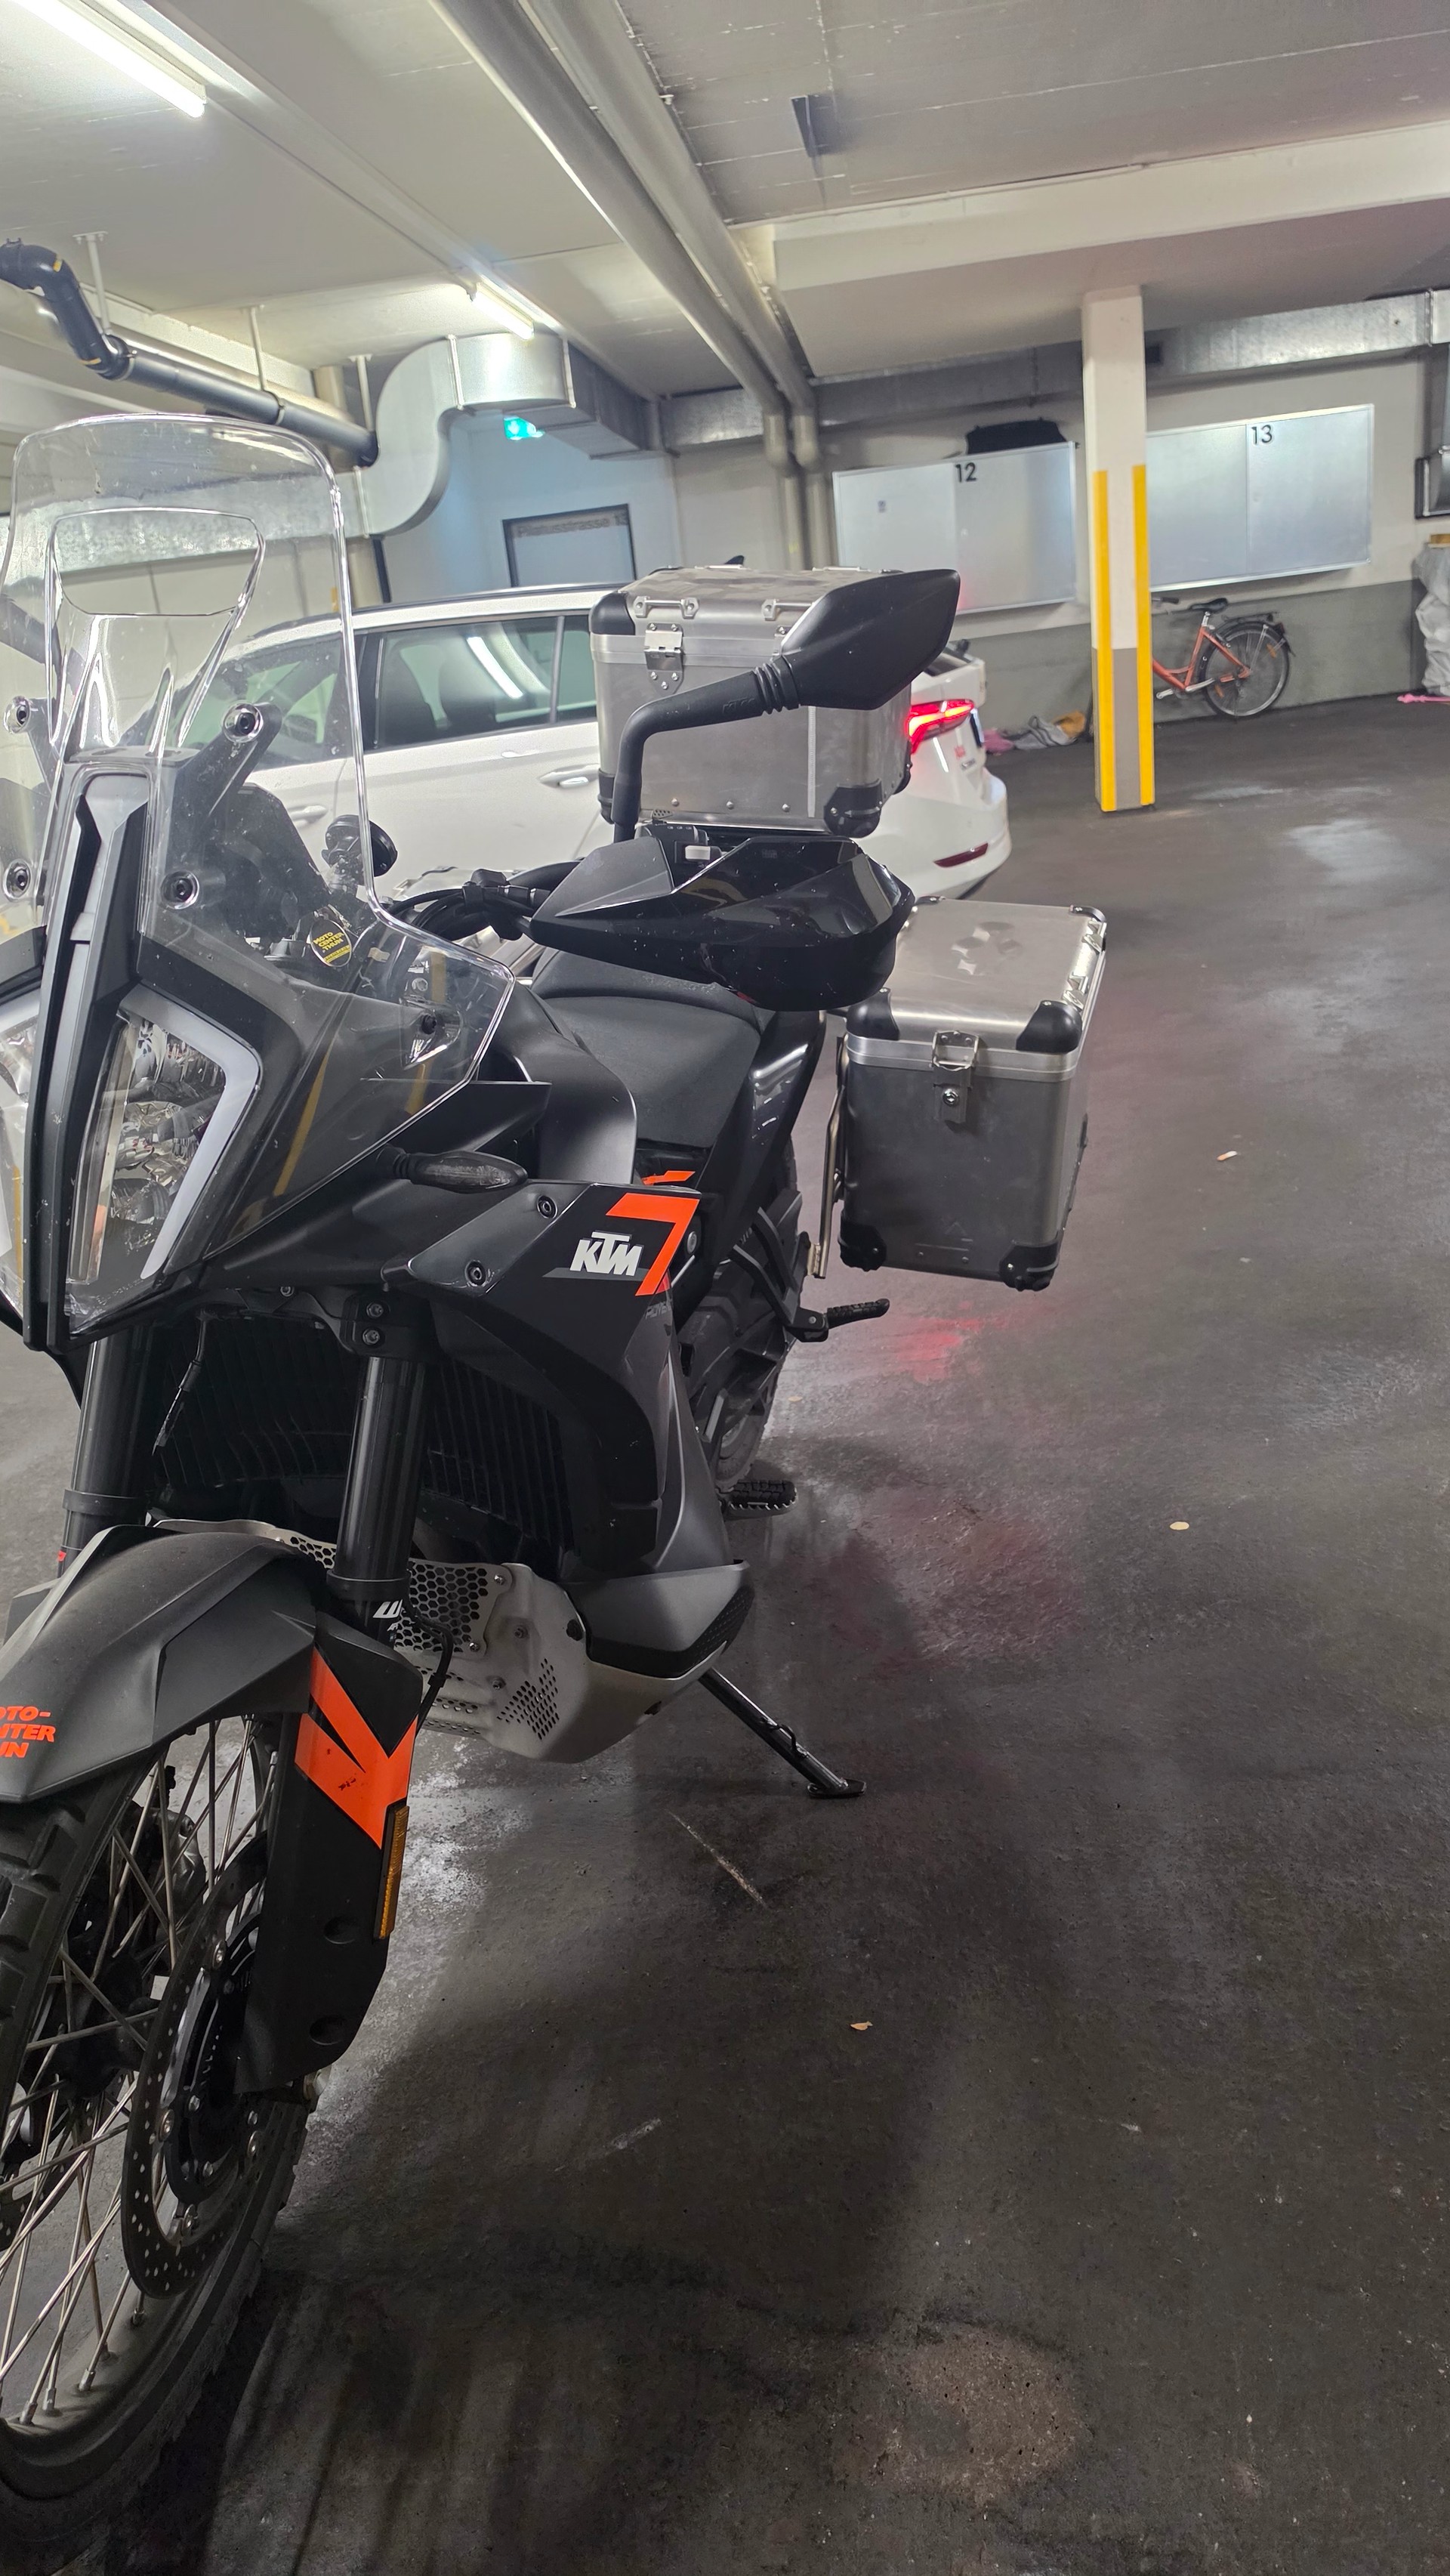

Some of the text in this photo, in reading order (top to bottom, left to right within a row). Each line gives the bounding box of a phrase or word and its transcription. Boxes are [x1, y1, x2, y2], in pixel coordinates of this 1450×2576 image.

[1251, 425, 1273, 445] 13
[955, 462, 976, 483] 12
[313, 931, 334, 944] MOTO
[318, 932, 344, 947] CENTER
[569, 1231, 643, 1277] KTM
